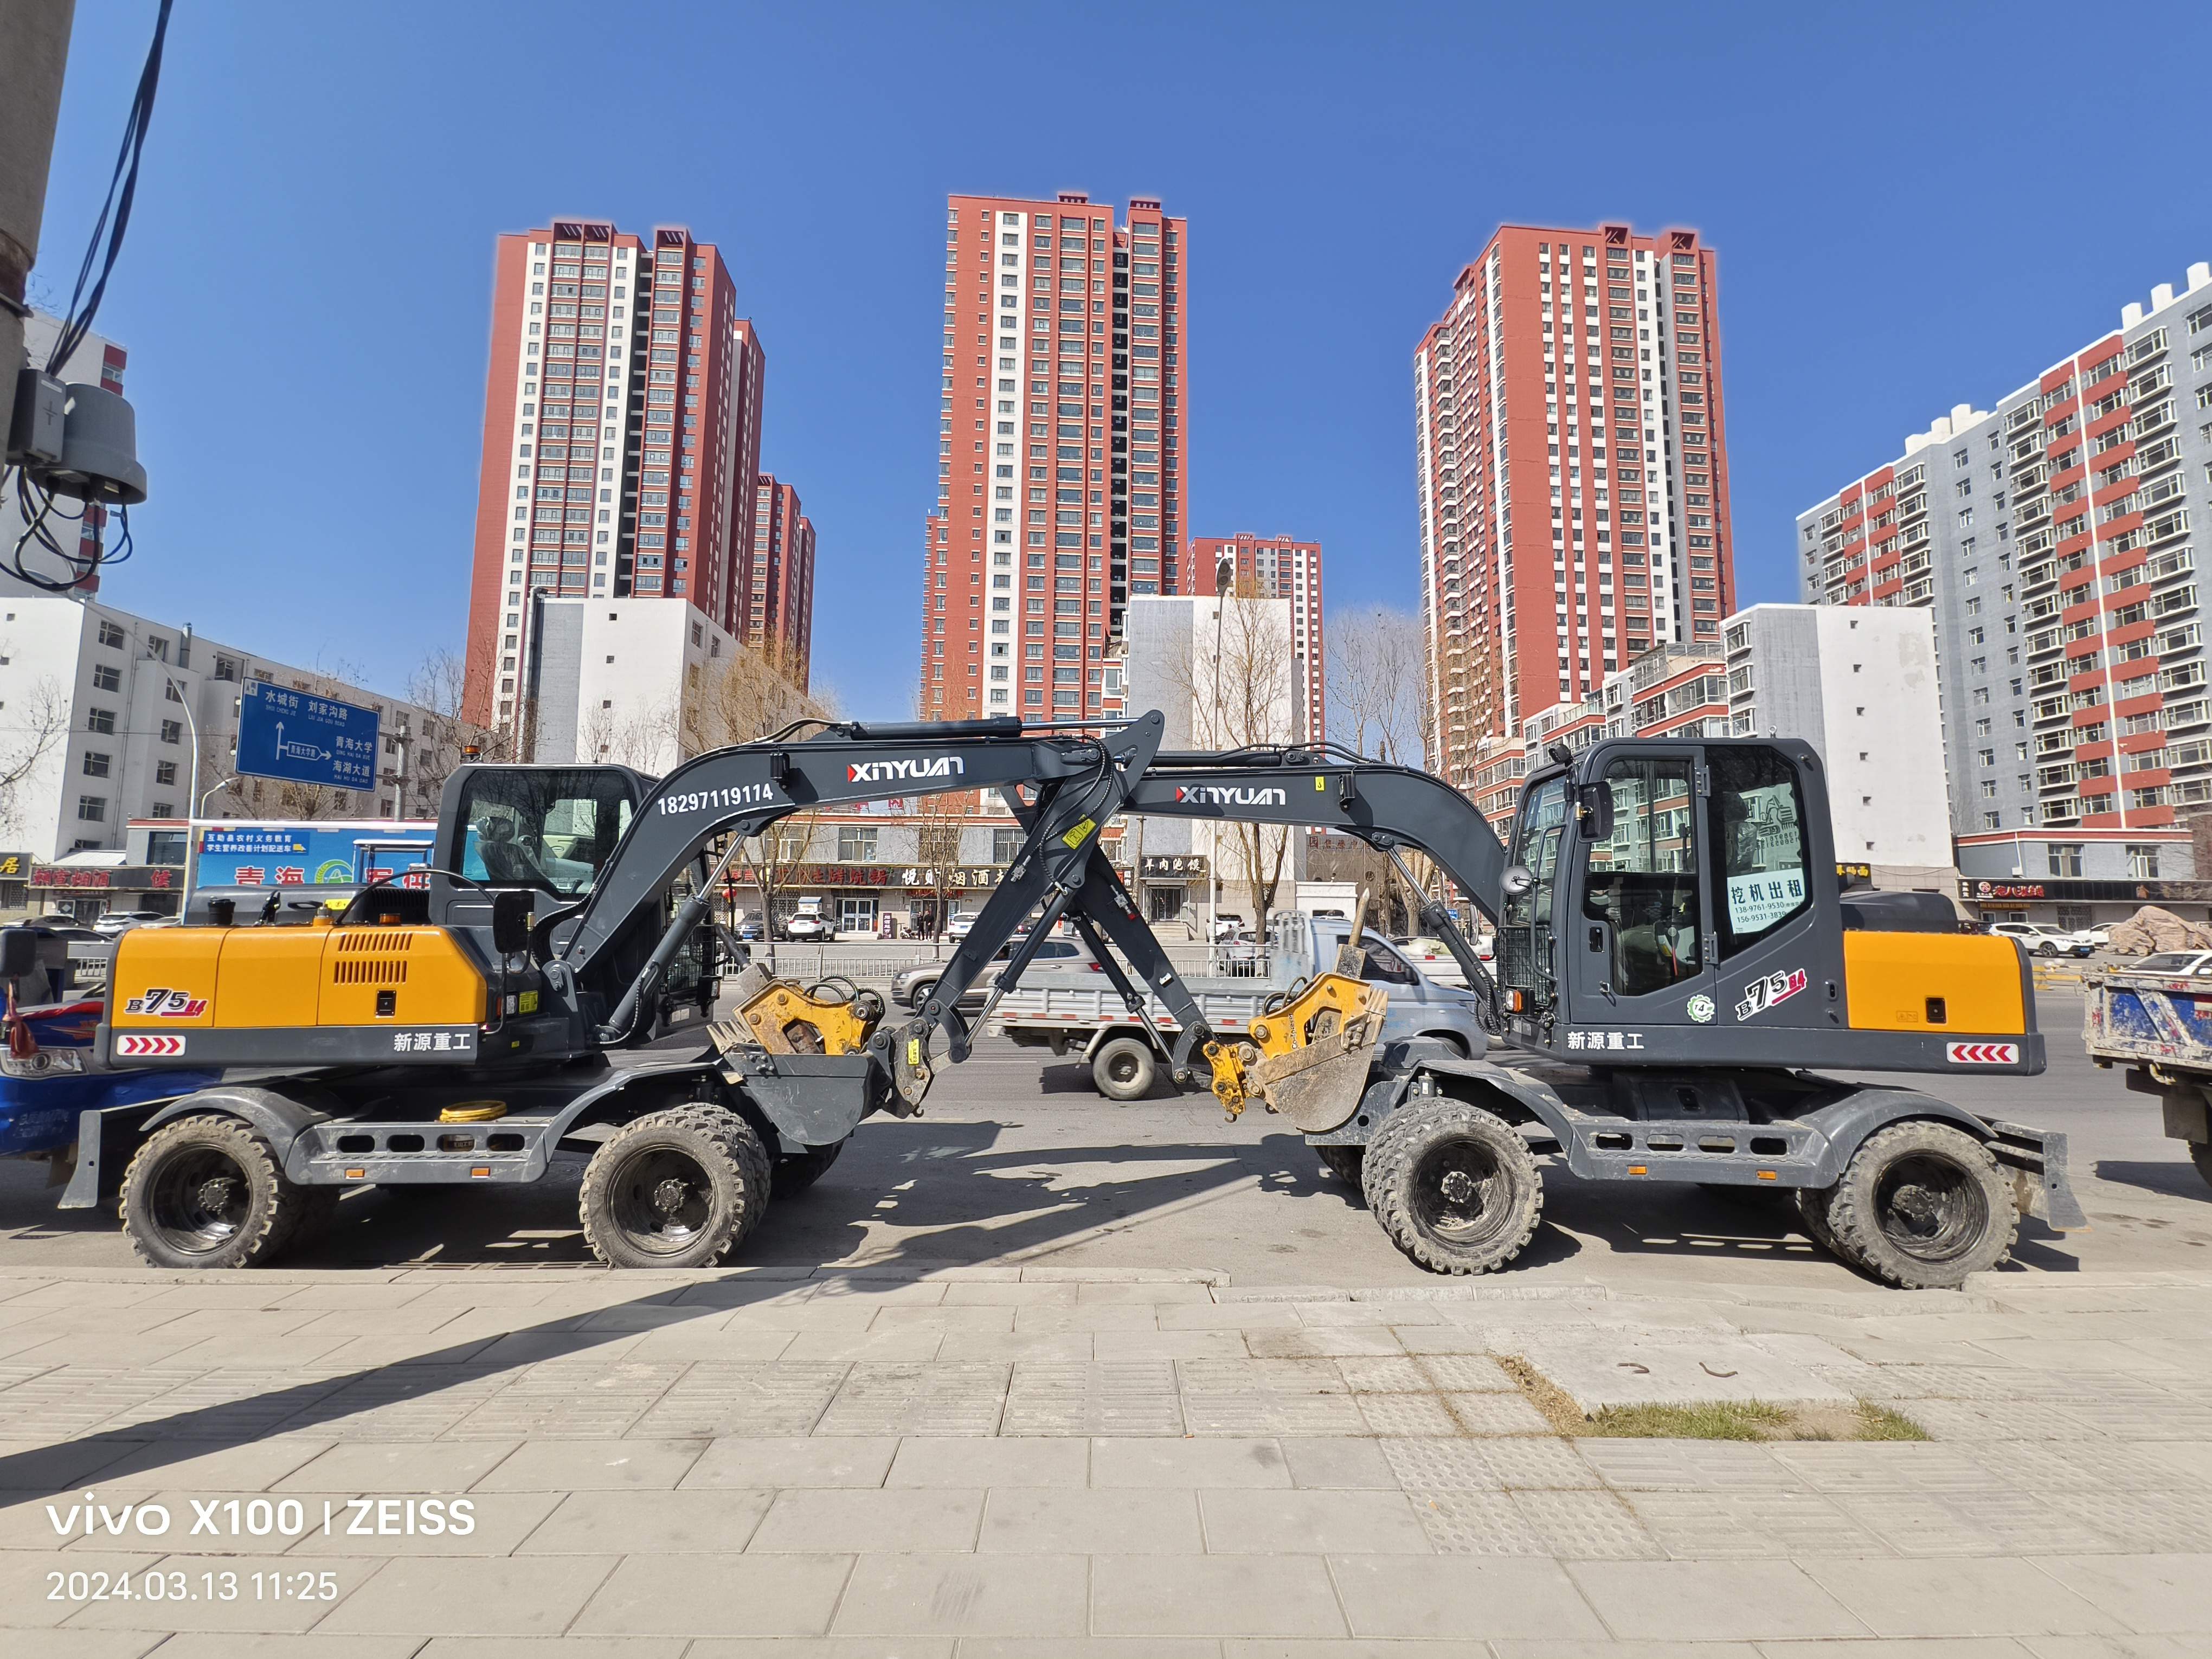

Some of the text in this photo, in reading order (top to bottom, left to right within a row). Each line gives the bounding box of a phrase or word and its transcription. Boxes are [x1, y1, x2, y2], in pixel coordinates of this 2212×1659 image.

[265, 690, 348, 721] 水城街 刘家沟路
[336, 736, 372, 753] 青海大学
[332, 760, 370, 776] 海湖大道
[658, 783, 774, 815] 18297119114
[207, 834, 292, 843] 互助县农村义务教育
[1144, 858, 1206, 873] 羊肉泡馍
[902, 868, 1007, 886] 悦购烟酒
[1731, 879, 1803, 904] 挖机出租
[1735, 902, 1784, 914] 138-9761-9530
[394, 1032, 471, 1052] 新源重工
[1567, 1031, 1644, 1050] 新源重工
